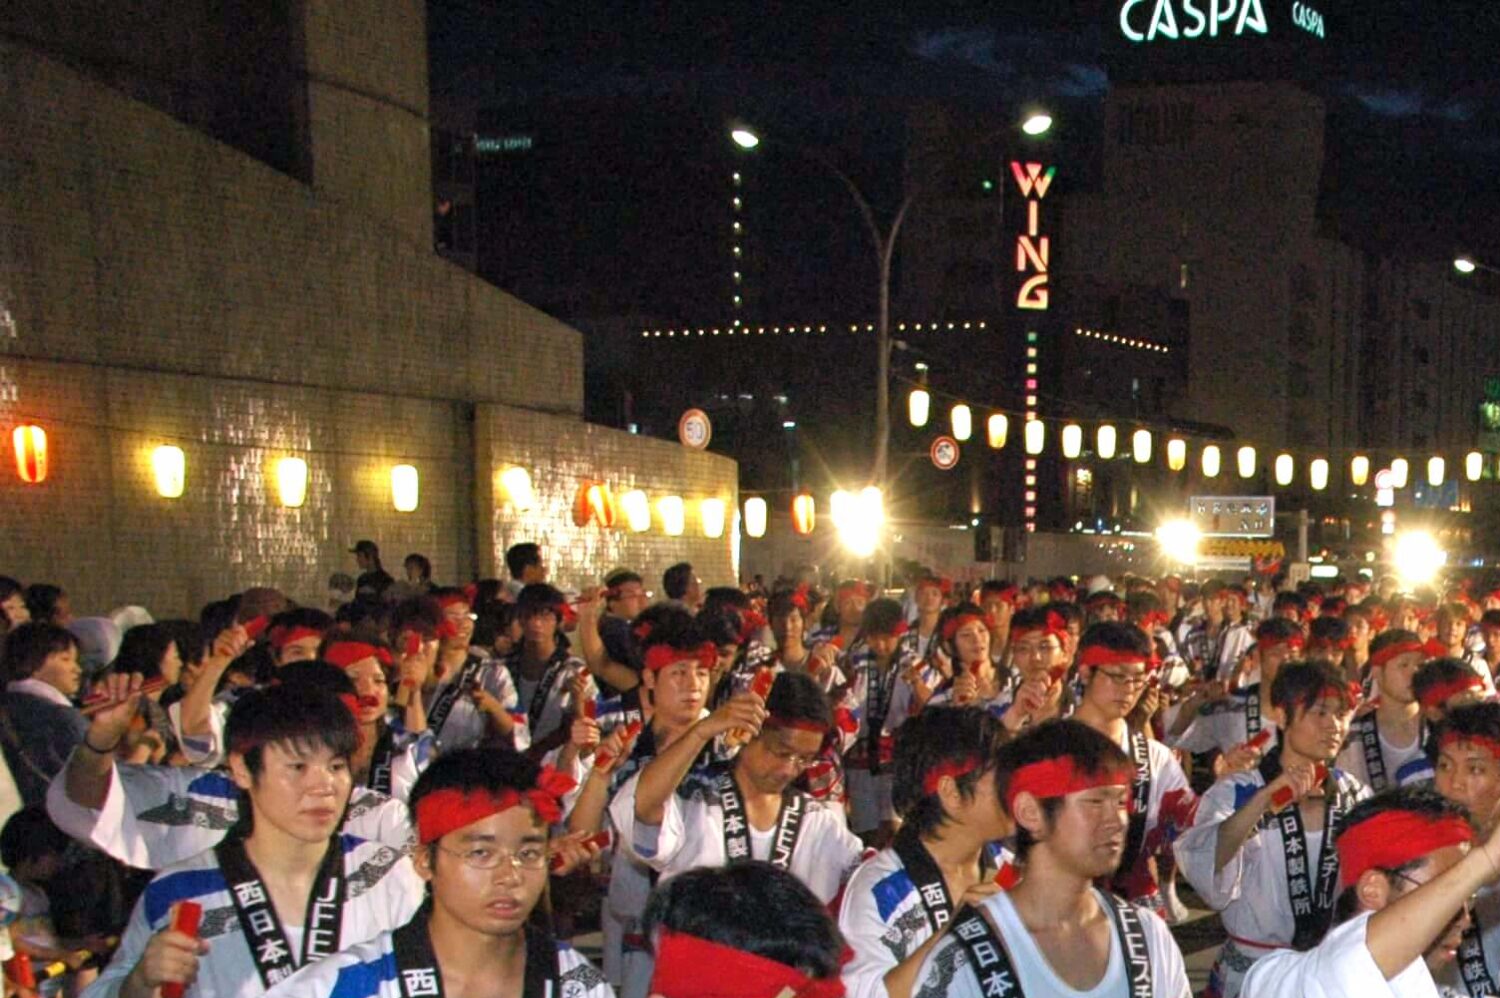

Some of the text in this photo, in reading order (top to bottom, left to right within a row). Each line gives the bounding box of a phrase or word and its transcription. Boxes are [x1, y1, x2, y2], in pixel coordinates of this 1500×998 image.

[1119, 0, 1268, 41] CASPA
[1292, 1, 1325, 39] CASPA
[1010, 160, 1057, 311] WING
[1283, 804, 1312, 916] 日本製鉄所
